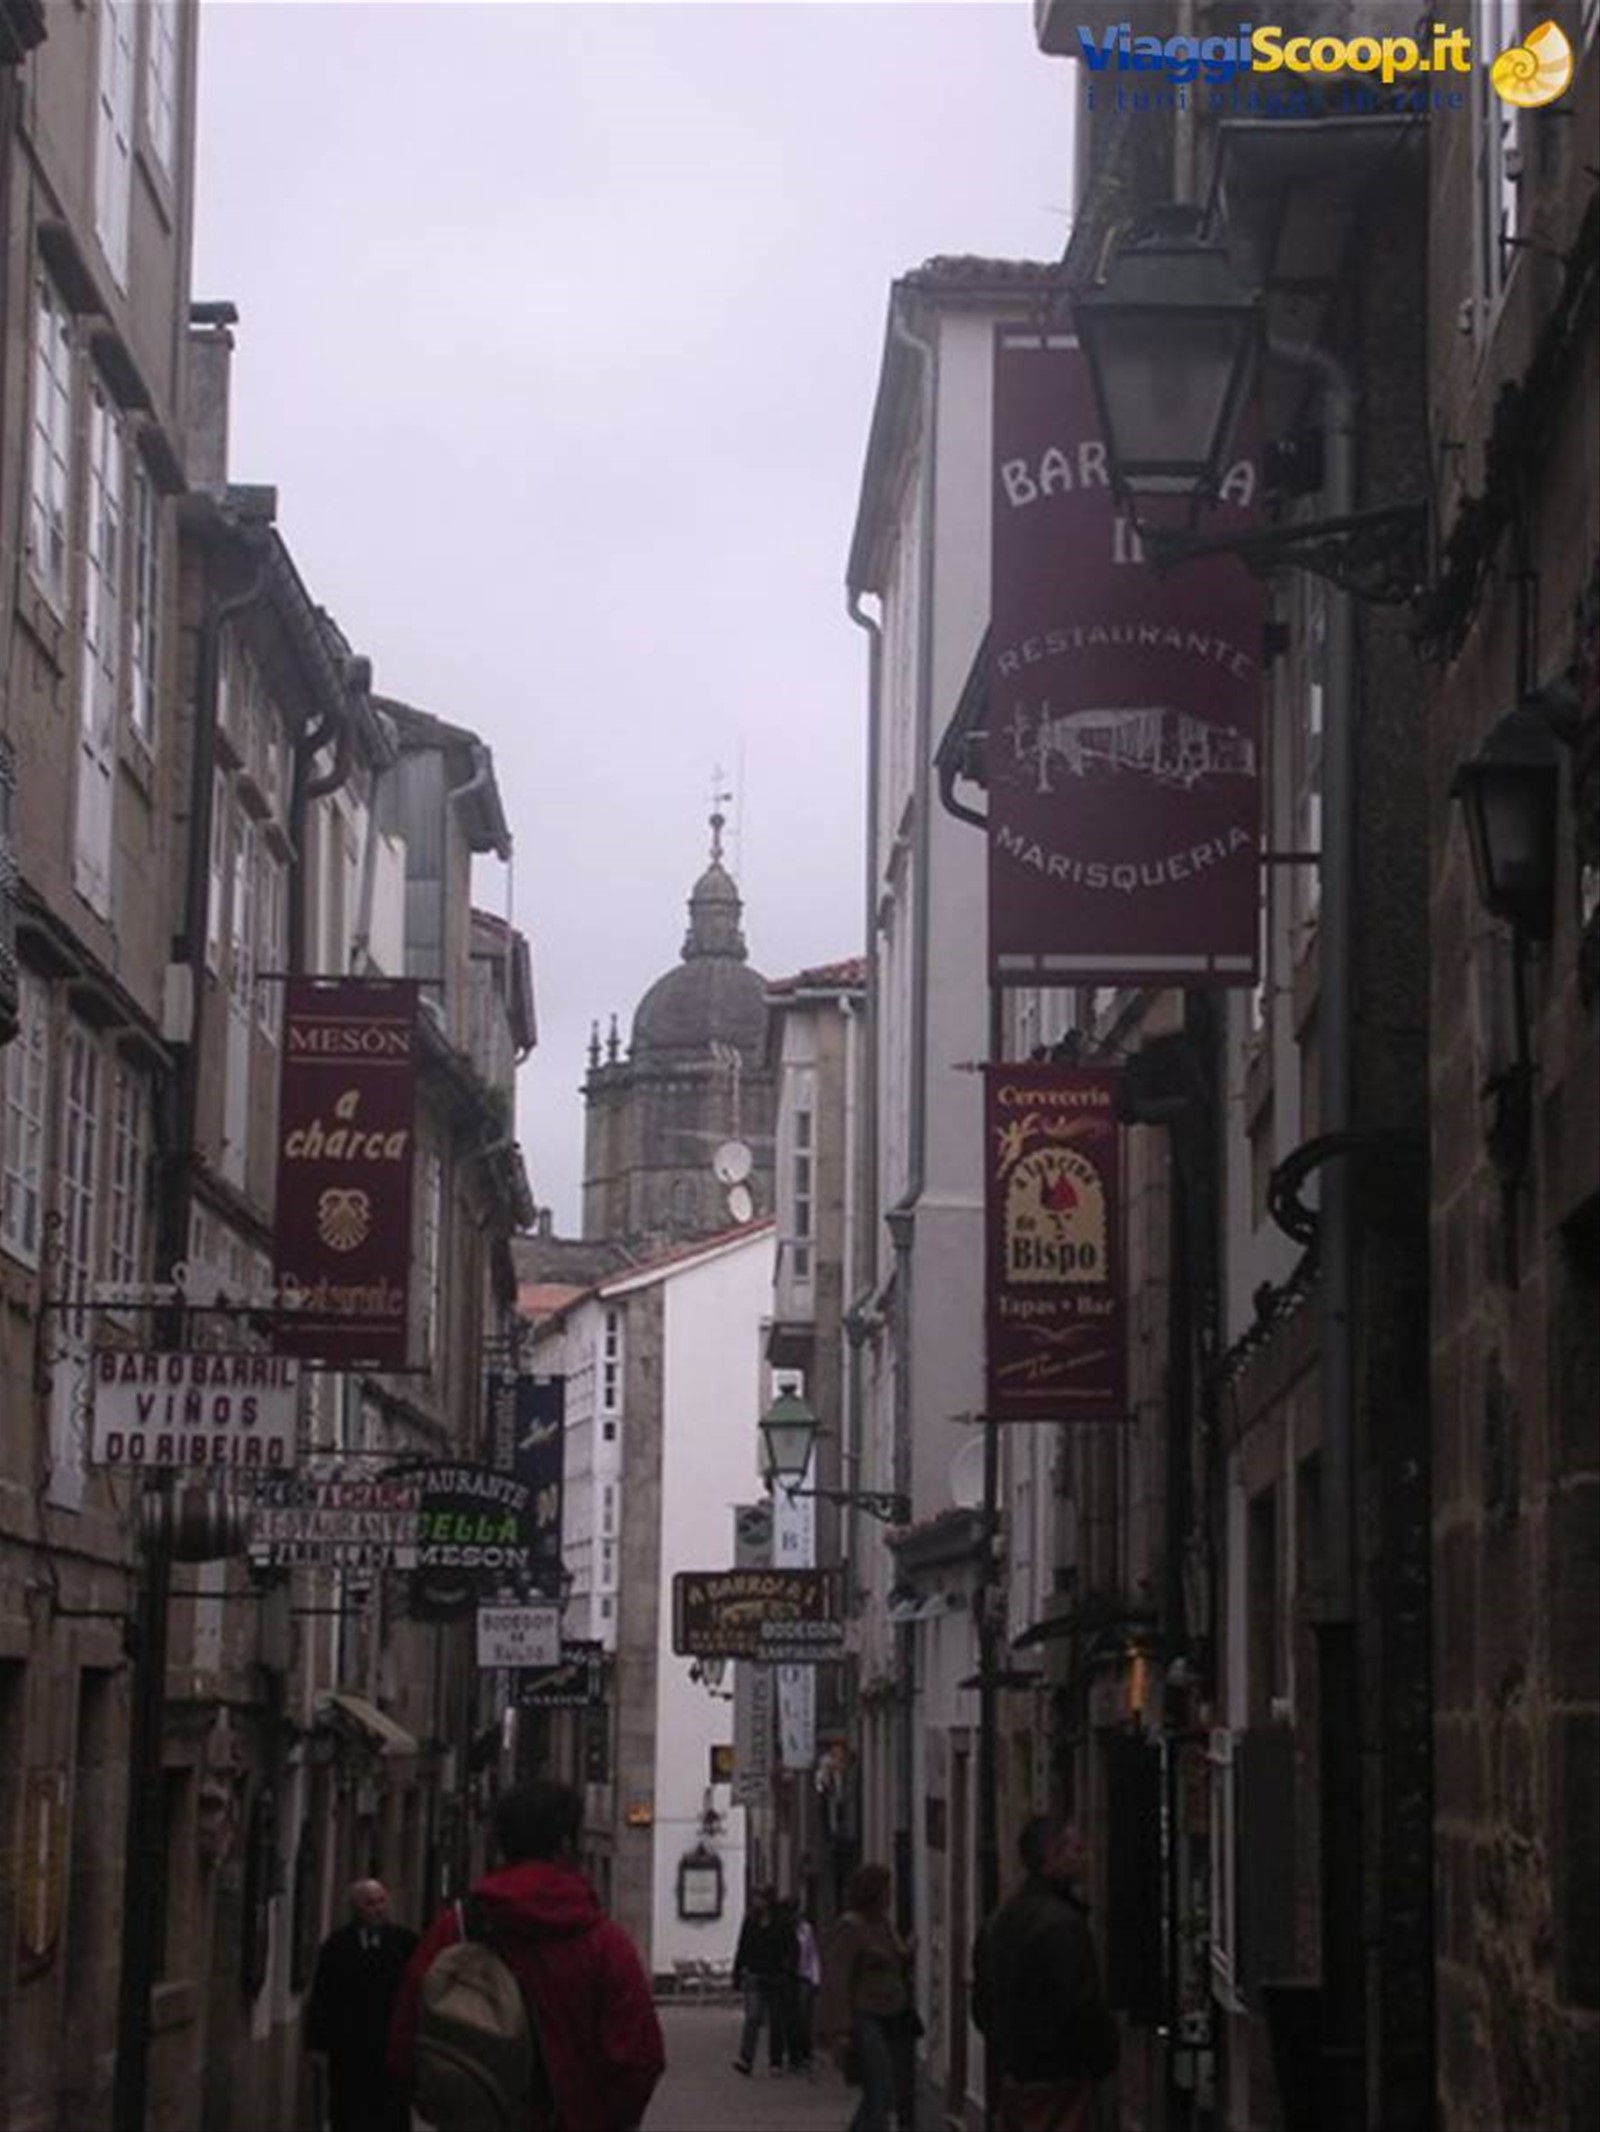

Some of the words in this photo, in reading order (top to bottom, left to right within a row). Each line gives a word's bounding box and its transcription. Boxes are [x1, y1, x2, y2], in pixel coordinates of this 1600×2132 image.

[1001, 440, 1256, 508] BARA
[999, 623, 1252, 681] RESTAURANTE
[996, 826, 1252, 893] MARISQUERIA
[284, 1118, 408, 1161] charca
[1012, 1236, 1097, 1276] Bispo
[100, 1352, 159, 1385] BAR
[166, 1354, 184, 1385] O
[190, 1354, 296, 1387] BARRIL
[136, 1387, 258, 1427] VIÑOS
[106, 1432, 145, 1462] DO
[155, 1433, 284, 1466] RIBEIRO
